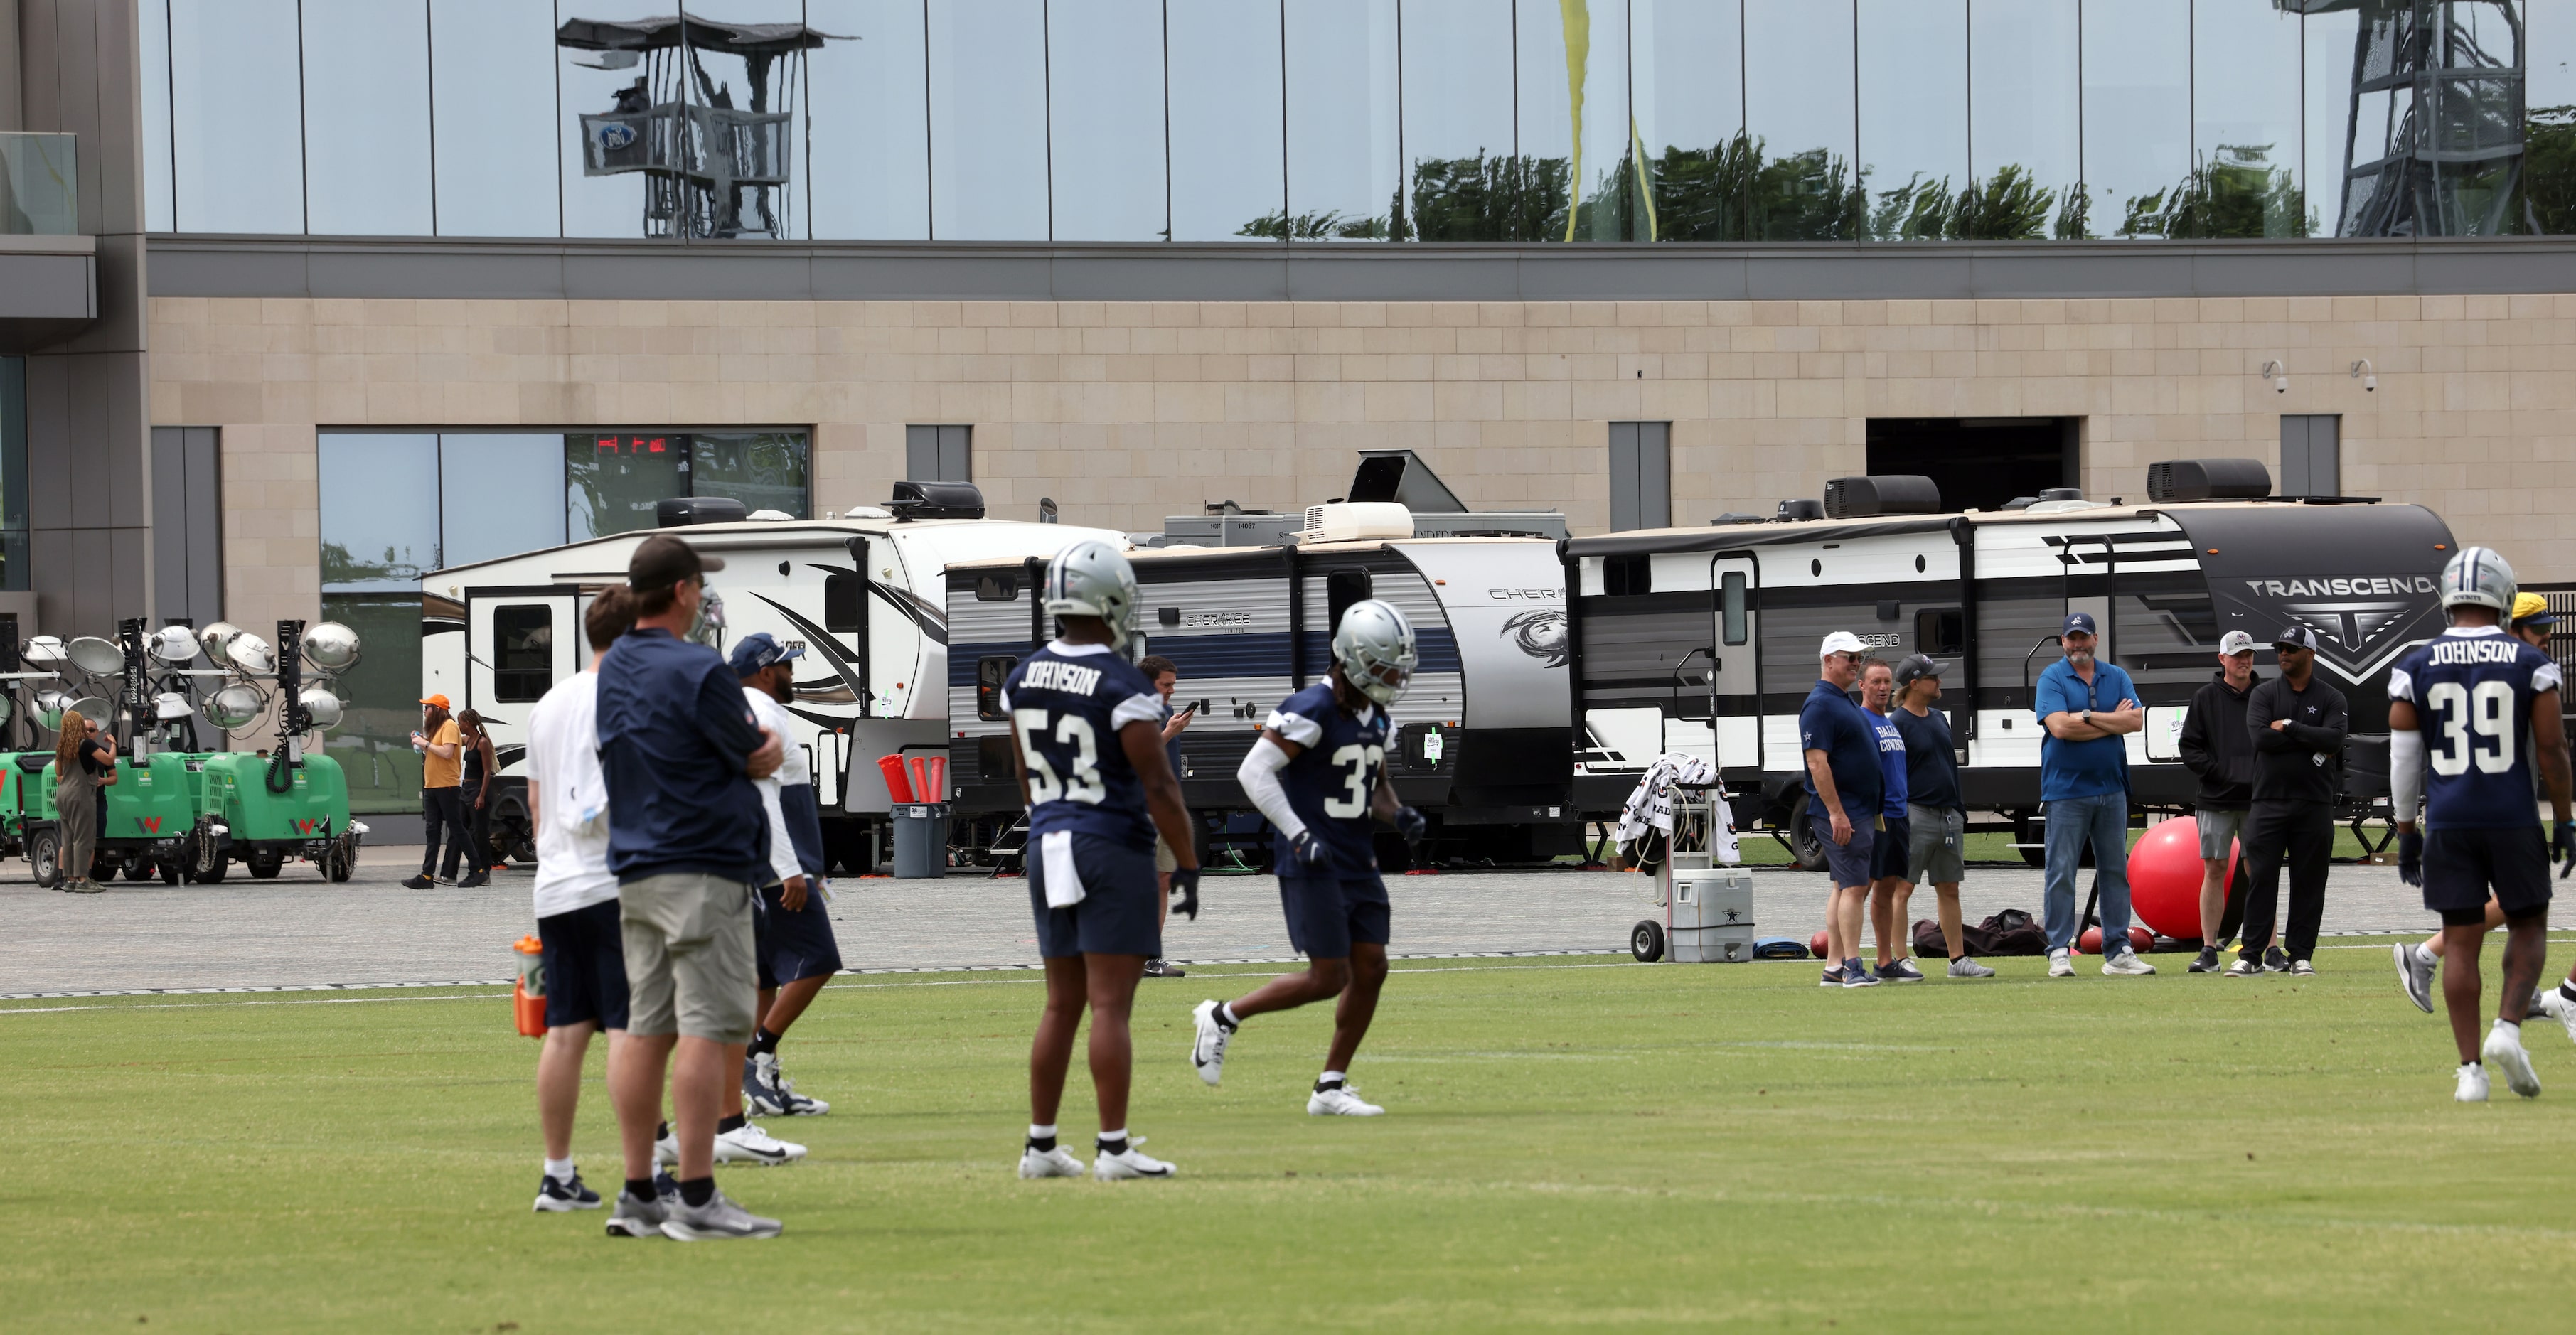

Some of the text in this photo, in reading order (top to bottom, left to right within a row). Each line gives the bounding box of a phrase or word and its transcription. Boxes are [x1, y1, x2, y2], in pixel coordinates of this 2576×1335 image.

[2245, 577, 2434, 596] TRANSCEND
[2428, 640, 2519, 666] JOHNSON
[1019, 660, 1101, 697] JOHNSON
[2427, 680, 2515, 776] 39
[1015, 708, 1106, 806] 53
